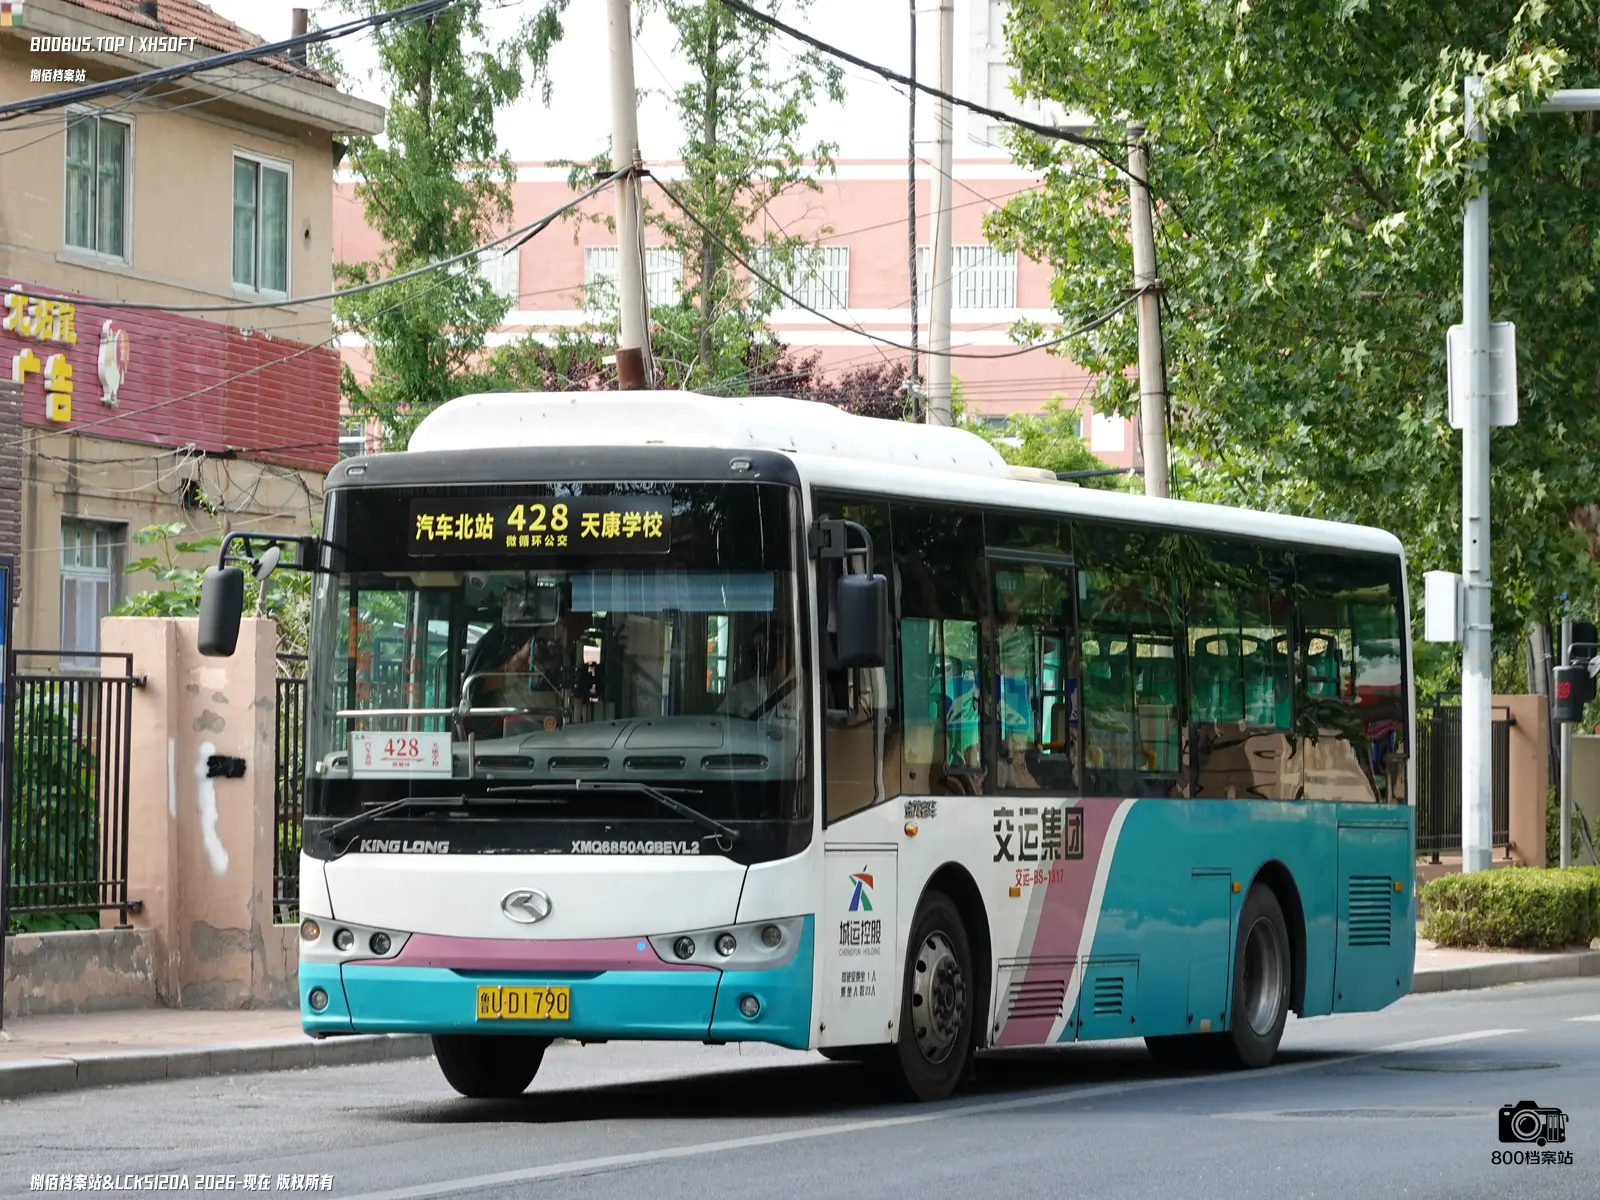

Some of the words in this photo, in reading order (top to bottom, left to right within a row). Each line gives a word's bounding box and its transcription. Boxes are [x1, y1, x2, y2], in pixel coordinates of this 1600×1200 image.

[415, 513, 494, 540] 汽车北站
[507, 503, 569, 531] 428
[580, 511, 663, 538] 天康学校
[505, 535, 568, 547] 微循环公交
[384, 738, 419, 757] 428
[993, 807, 1084, 862] 交运集团
[360, 839, 401, 853] KING
[402, 840, 450, 853] LONG
[839, 920, 881, 945] 城运控股
[863, 947, 880, 956] HOLDING
